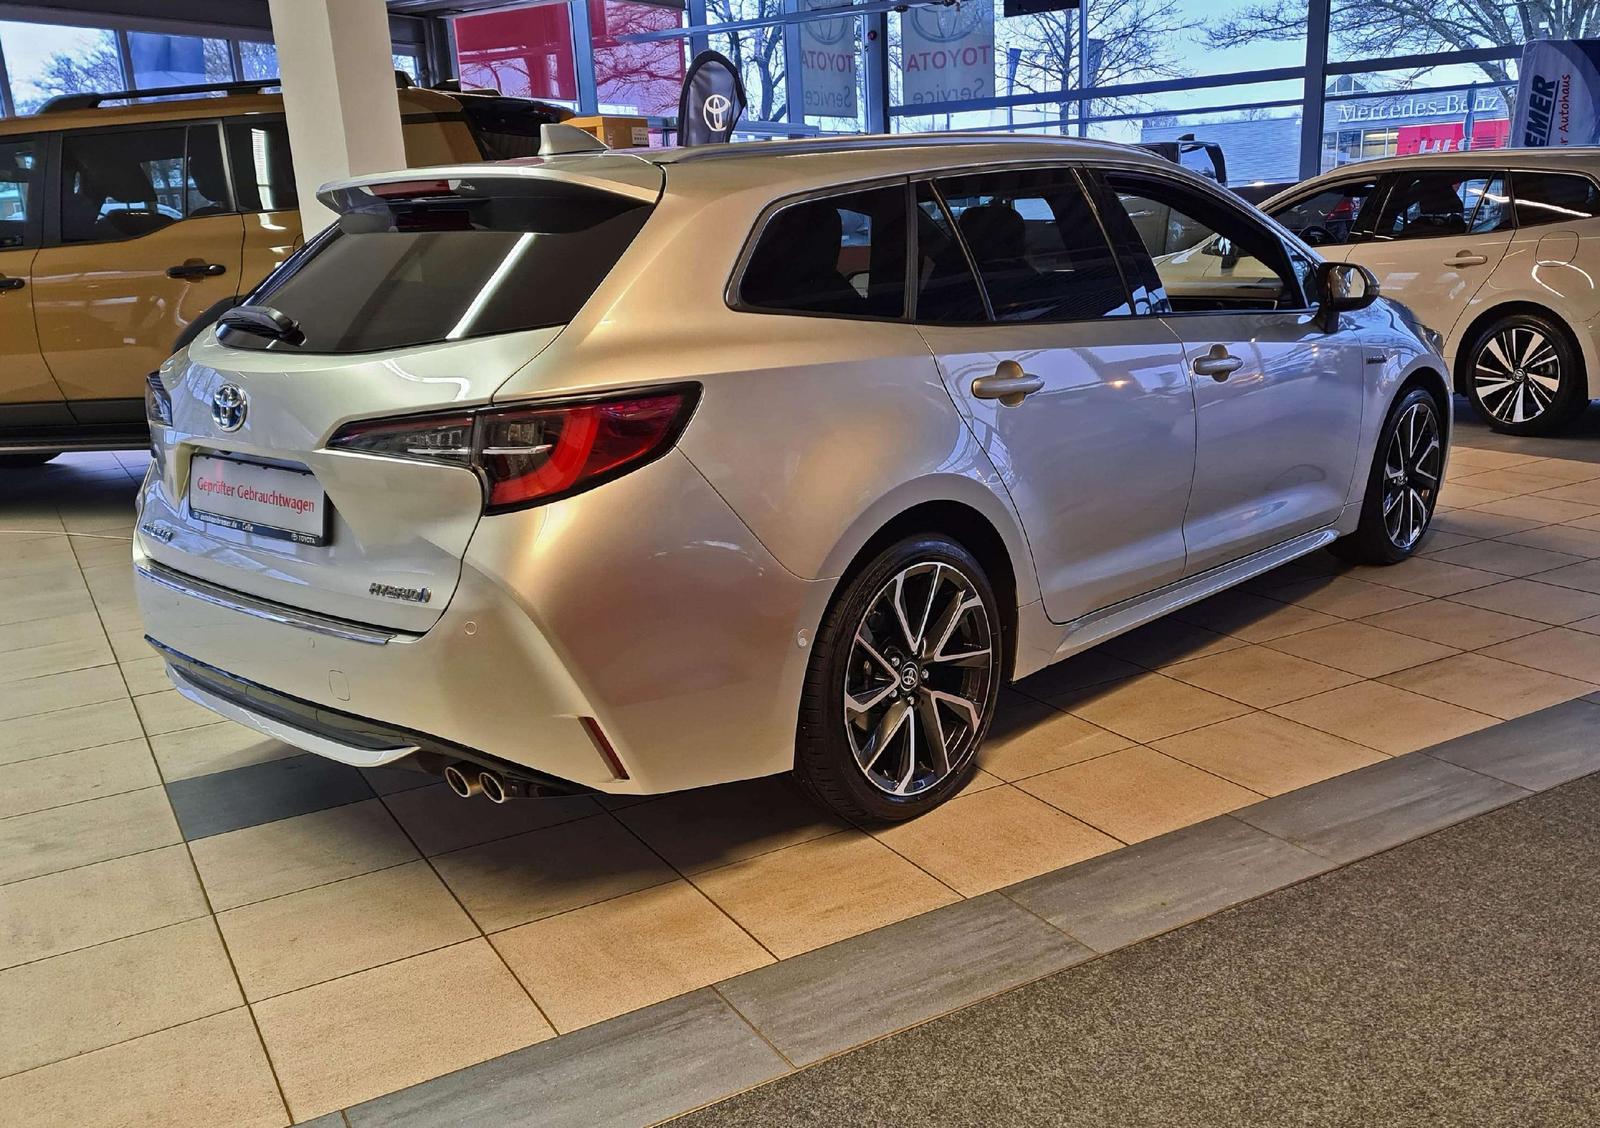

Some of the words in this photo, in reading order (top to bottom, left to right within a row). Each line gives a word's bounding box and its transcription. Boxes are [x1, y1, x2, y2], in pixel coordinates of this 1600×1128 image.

[1337, 94, 1499, 123] Mercedes-Benz
[1558, 73, 1571, 133] Autohaus
[197, 476, 235, 497] Geprüfter
[237, 485, 315, 515] Gebrauchtwagen
[298, 535, 316, 545] TOYOTA
